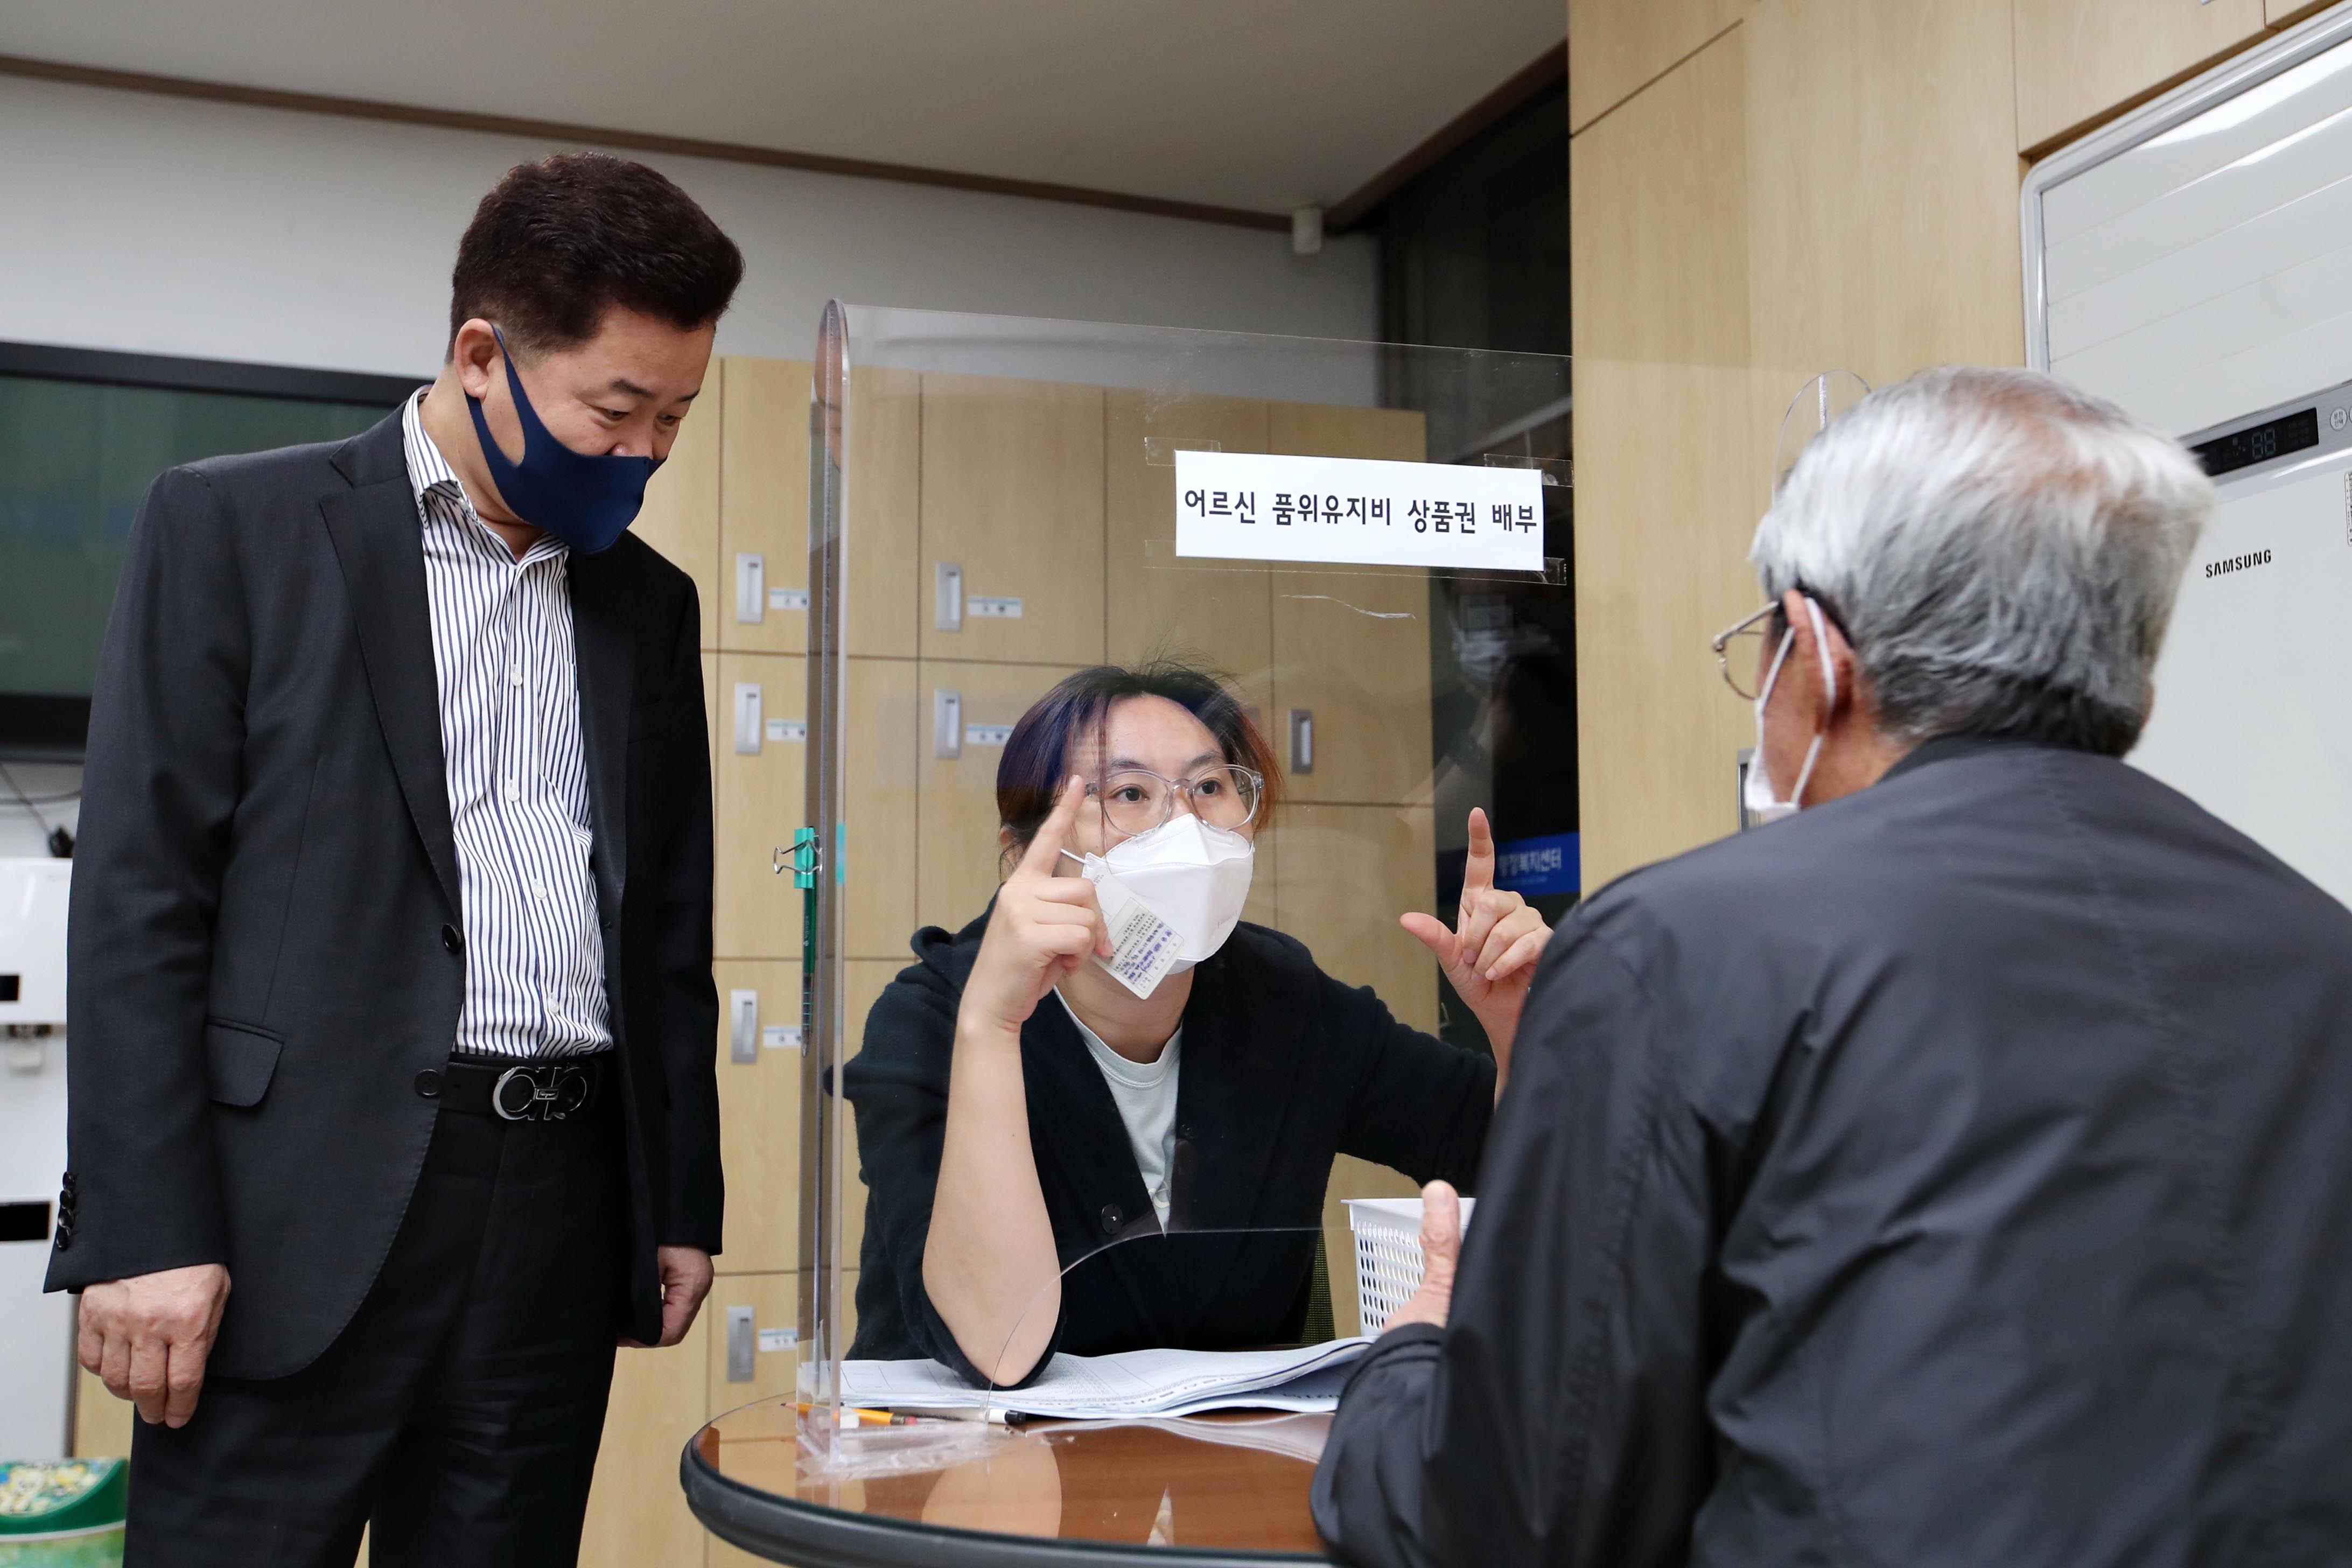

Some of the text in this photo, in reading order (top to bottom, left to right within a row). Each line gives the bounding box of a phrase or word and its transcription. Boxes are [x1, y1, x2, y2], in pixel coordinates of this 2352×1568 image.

[1184, 489, 1537, 534] 어르신 품위유지비 상품권 배부
[2206, 549, 2272, 578] SAMSUNG
